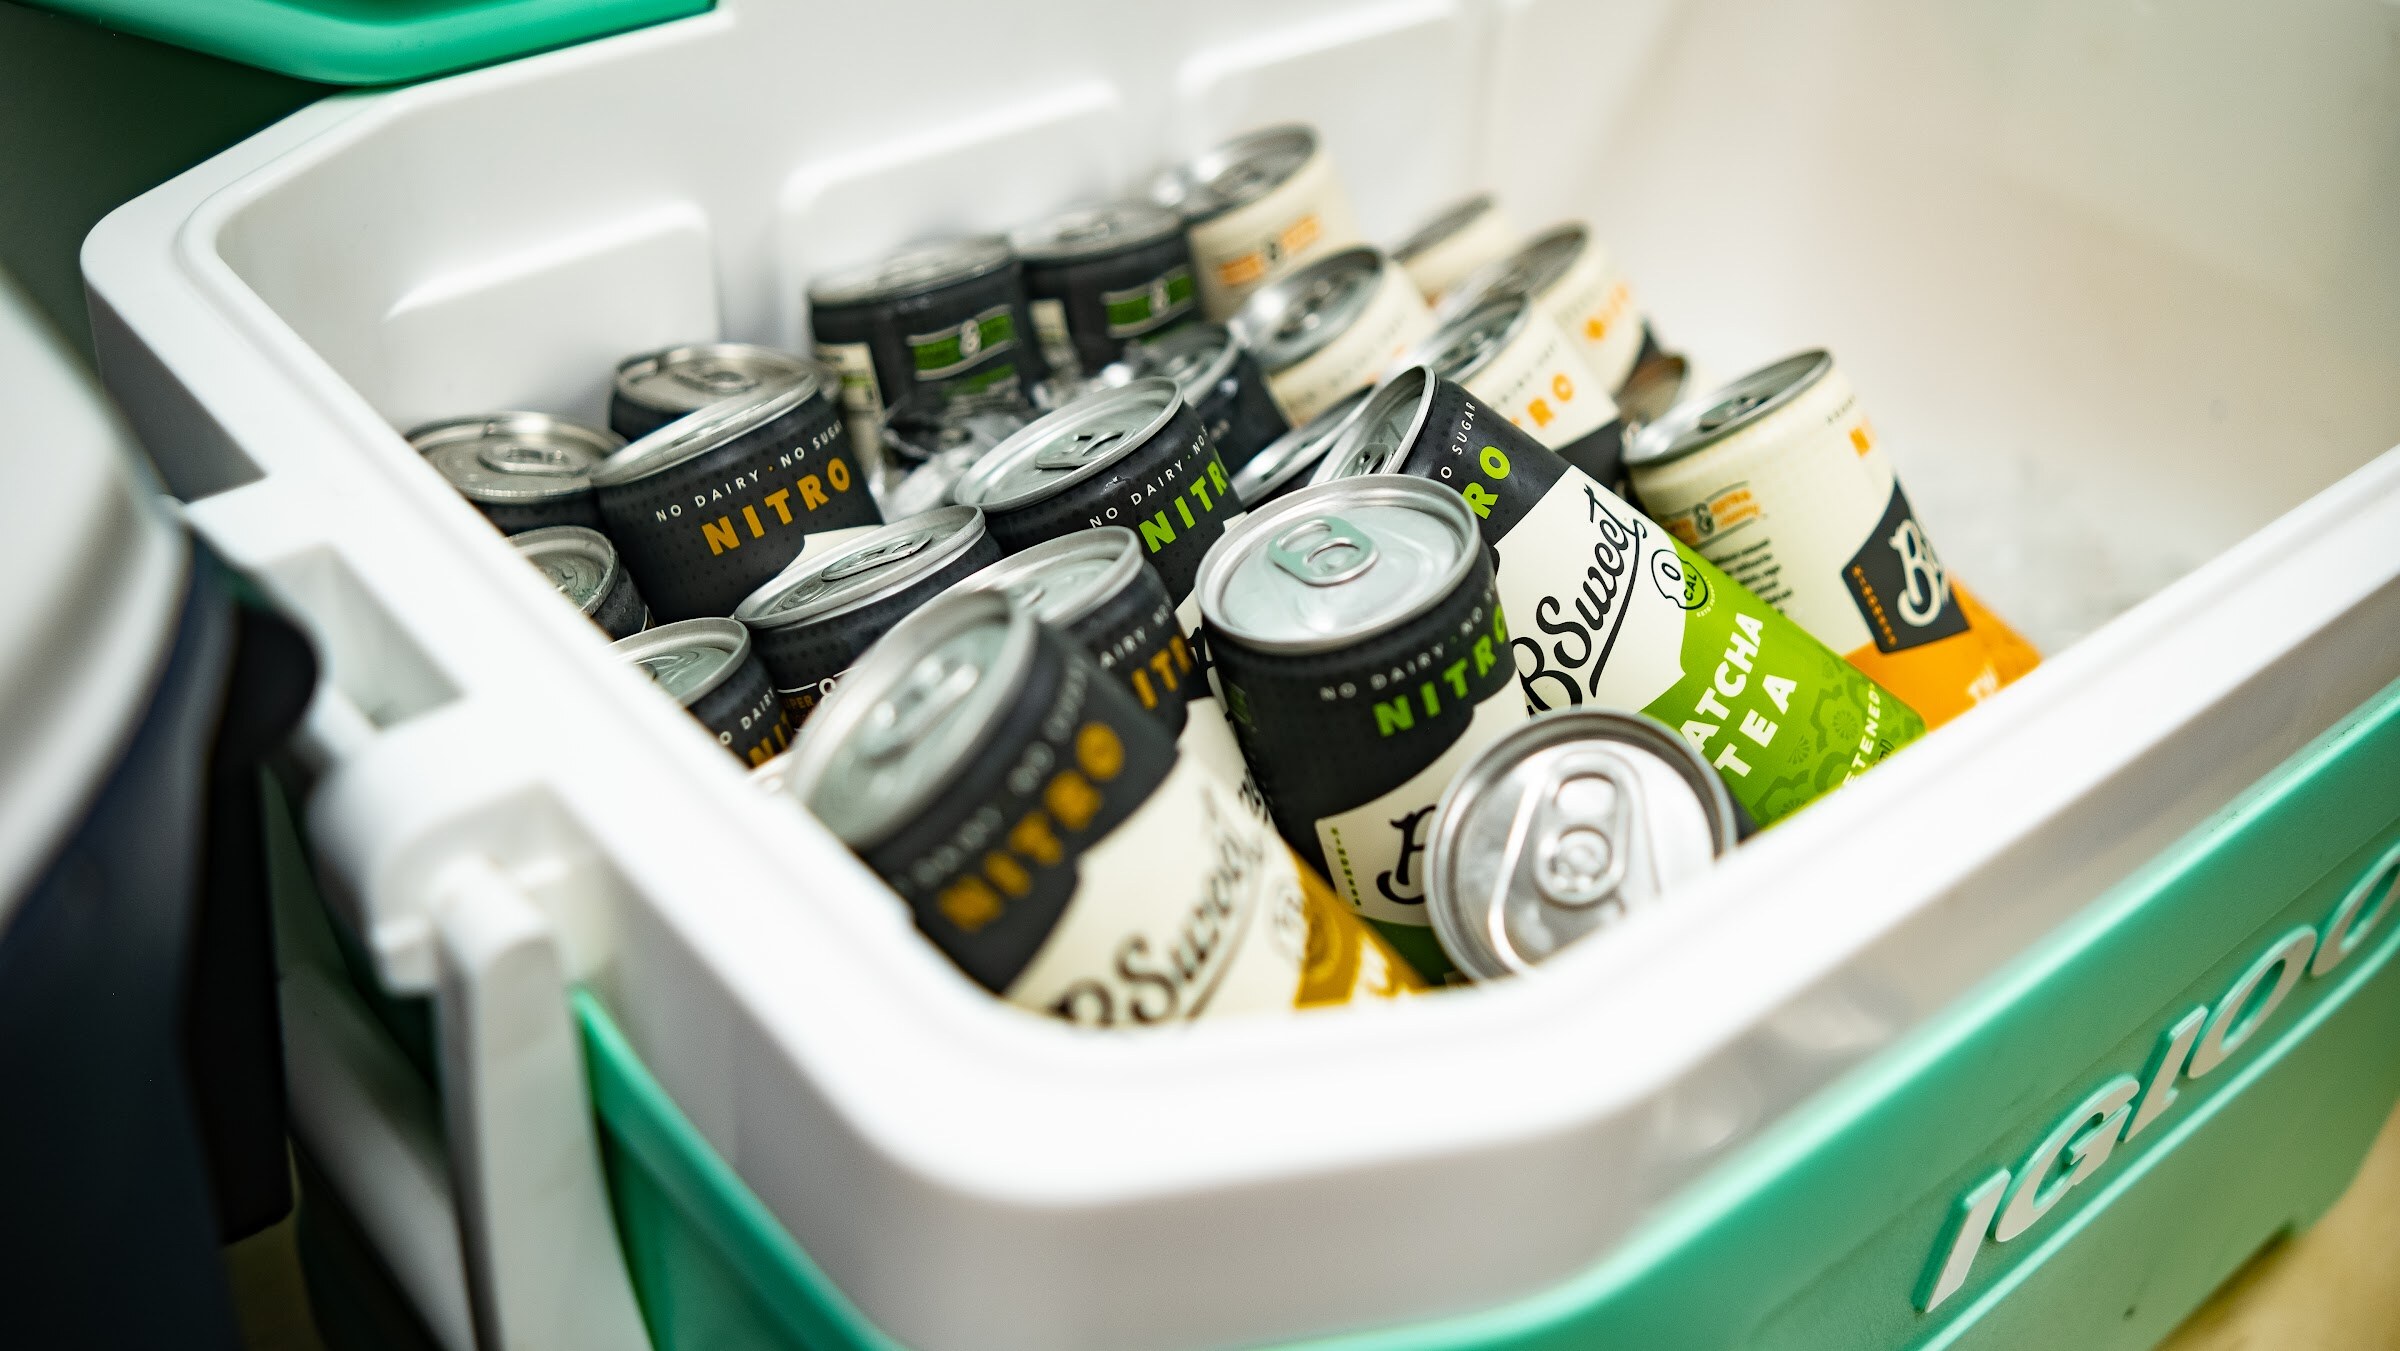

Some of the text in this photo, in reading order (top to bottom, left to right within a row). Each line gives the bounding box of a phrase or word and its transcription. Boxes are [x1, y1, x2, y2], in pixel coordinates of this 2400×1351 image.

[1451, 401, 1477, 456] SUGAR
[655, 504, 682, 523] NO
[694, 469, 760, 508] DAIRY
[780, 446, 806, 468] NO
[701, 457, 851, 556] NITRO
[1089, 434, 1206, 529] NO DAIRY NO
[1138, 450, 1229, 554] NITR
[1683, 574, 1697, 601] CAL
[1100, 625, 1146, 672] AIRY
[1320, 606, 1484, 701] NO DAIRY NO
[1372, 604, 1508, 738] NITRO
[1679, 612, 1764, 753] ATCHA
[740, 686, 775, 731] DAIRY
[1713, 674, 1798, 778] TEA
[938, 722, 1125, 933] NITRO
[1922, 840, 2400, 1314] IGLOO
